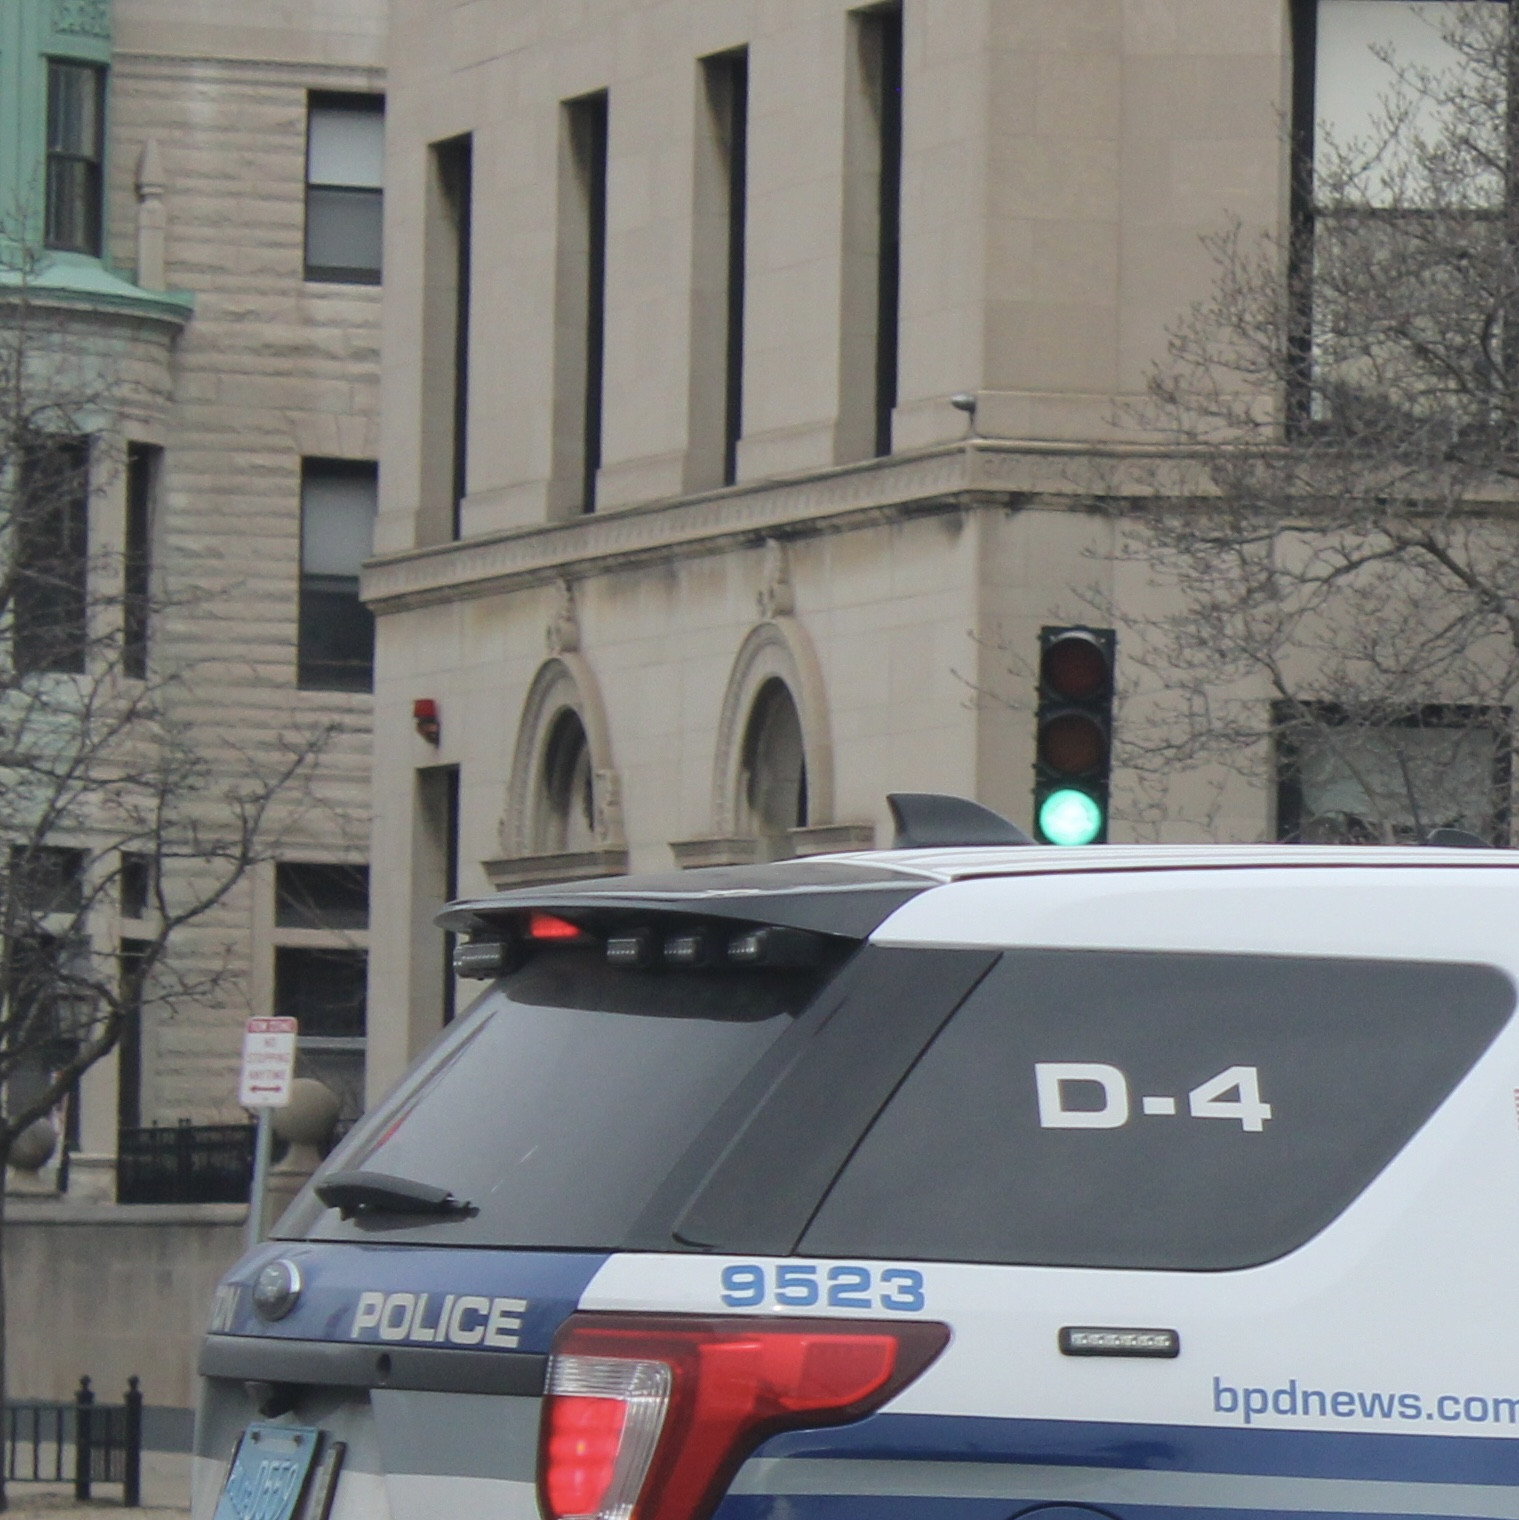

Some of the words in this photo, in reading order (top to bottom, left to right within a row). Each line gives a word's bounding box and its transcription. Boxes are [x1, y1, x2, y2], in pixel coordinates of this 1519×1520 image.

[1034, 1062, 1273, 1132] D-4
[720, 1264, 925, 1312] 9523
[352, 1291, 528, 1348] POLICE
